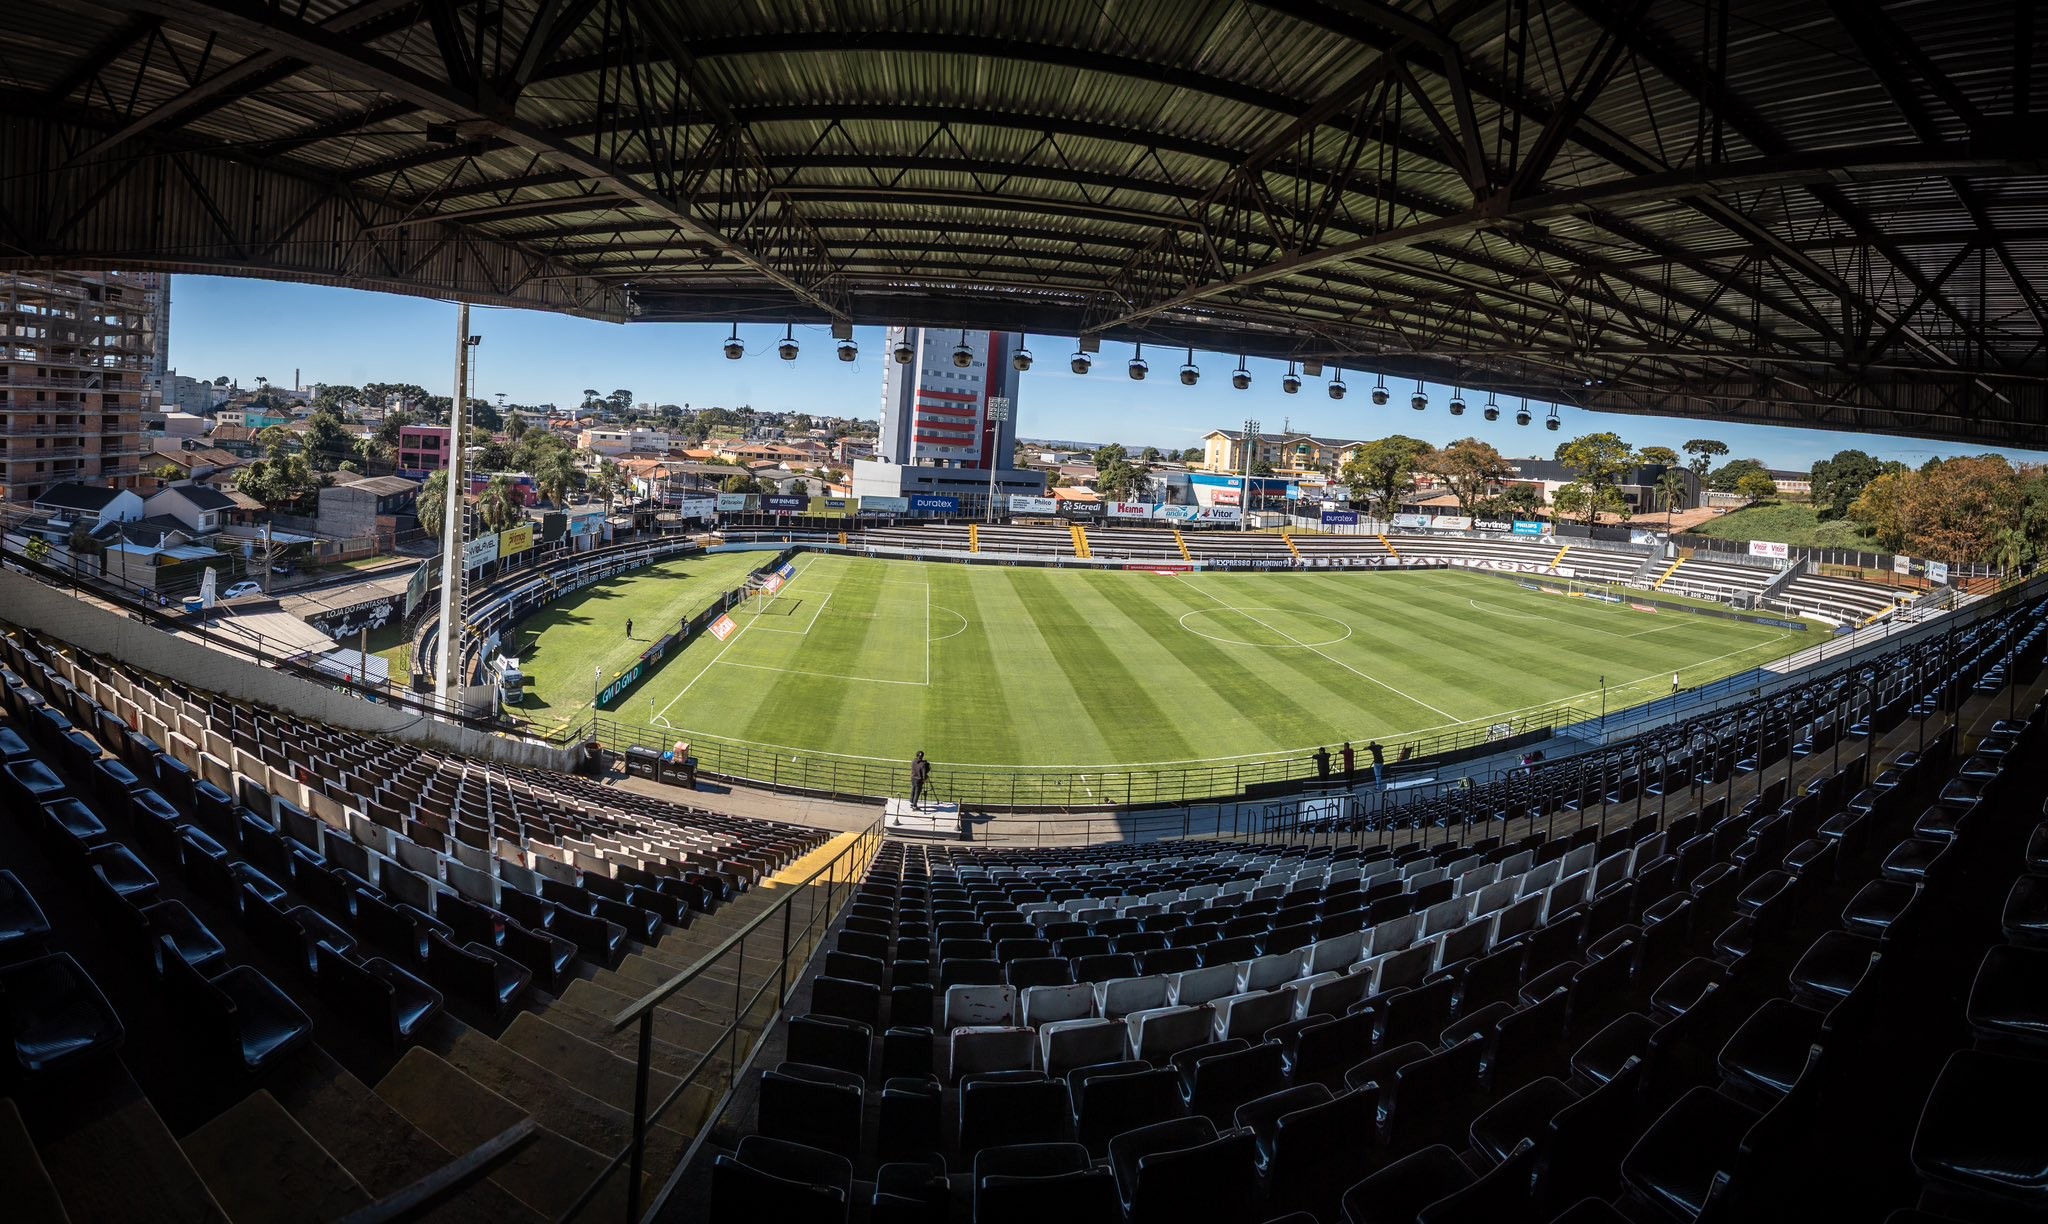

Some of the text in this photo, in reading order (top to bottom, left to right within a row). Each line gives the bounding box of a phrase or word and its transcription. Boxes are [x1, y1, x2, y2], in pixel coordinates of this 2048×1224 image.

[917, 499, 952, 508] Duratex
[1034, 498, 1052, 506] Philco
[1073, 502, 1101, 511] Sicredi
[1212, 509, 1233, 518] Vitor
[1474, 518, 1512, 530] Servtintas
[1753, 543, 1767, 551] Vitor
[1216, 559, 1283, 567] EXPRESSO FEMININO
[326, 597, 390, 619] LOJA DO FANTASMA
